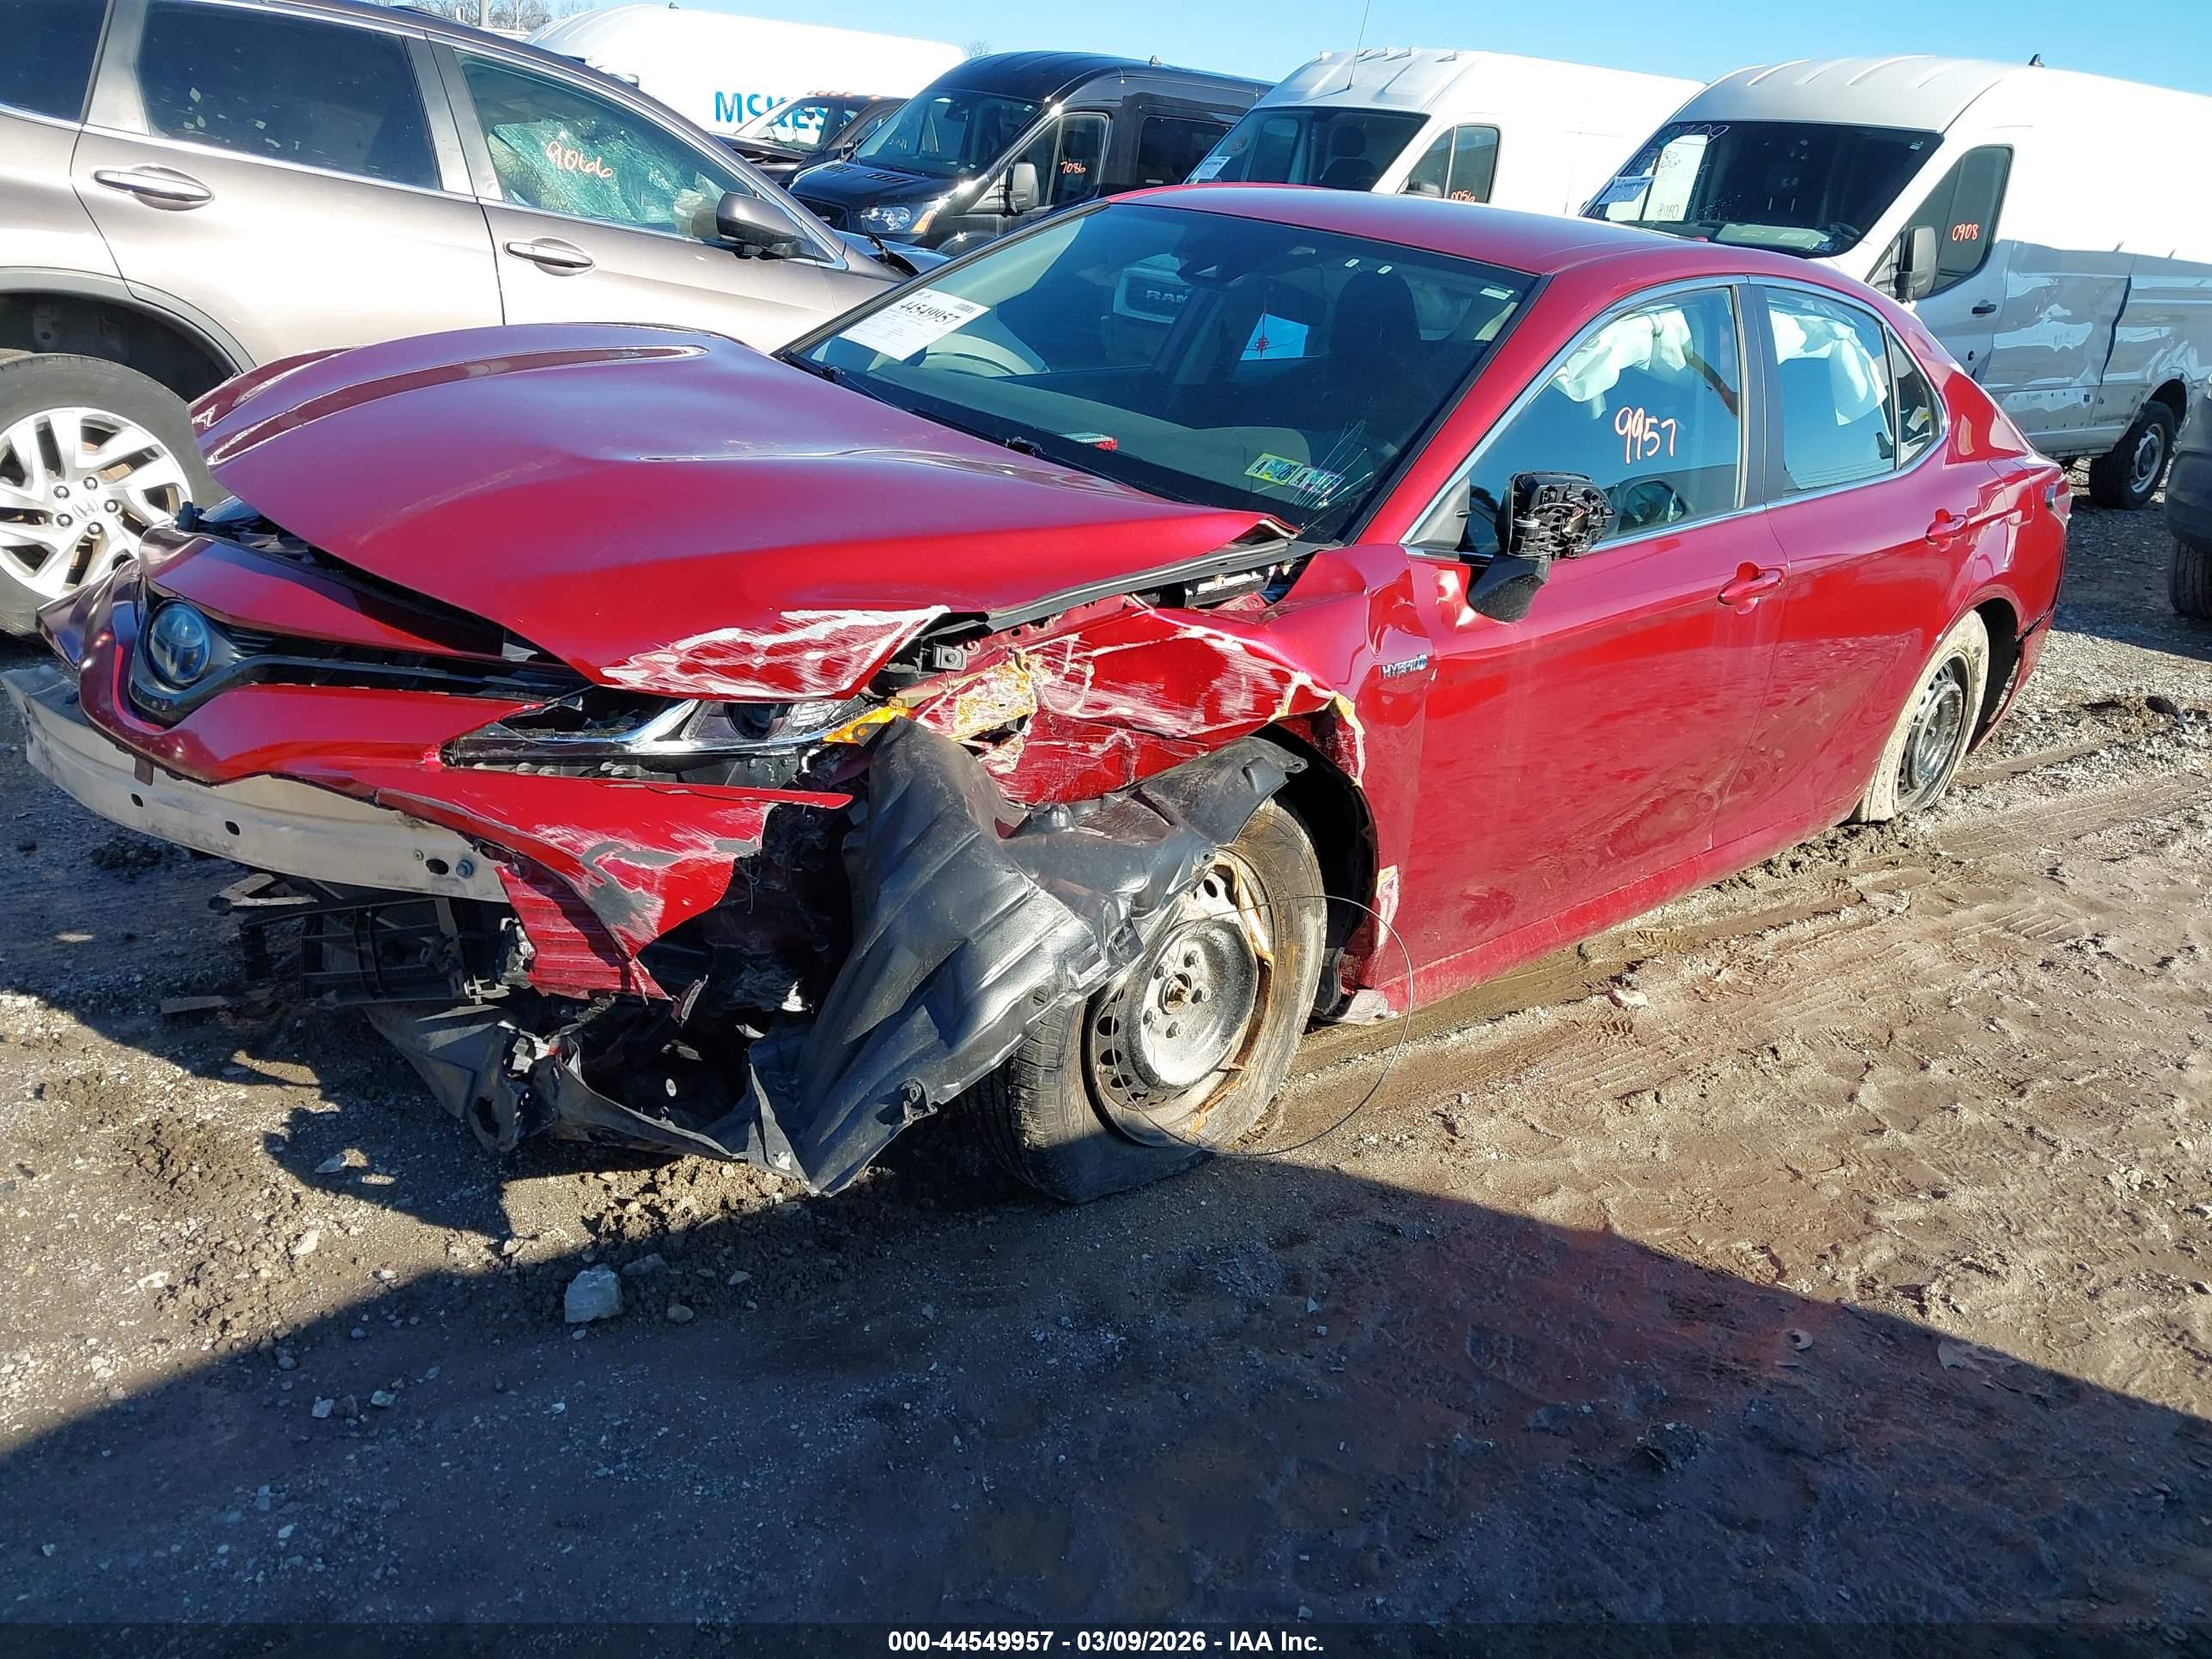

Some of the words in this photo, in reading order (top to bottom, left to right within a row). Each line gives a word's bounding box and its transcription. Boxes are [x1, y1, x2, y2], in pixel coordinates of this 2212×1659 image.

[546, 141, 613, 179] 9066
[1060, 161, 1086, 174] 7086
[1952, 223, 1979, 241] 0908
[899, 301, 962, 325] 44549957
[1614, 406, 1676, 465] 9957
